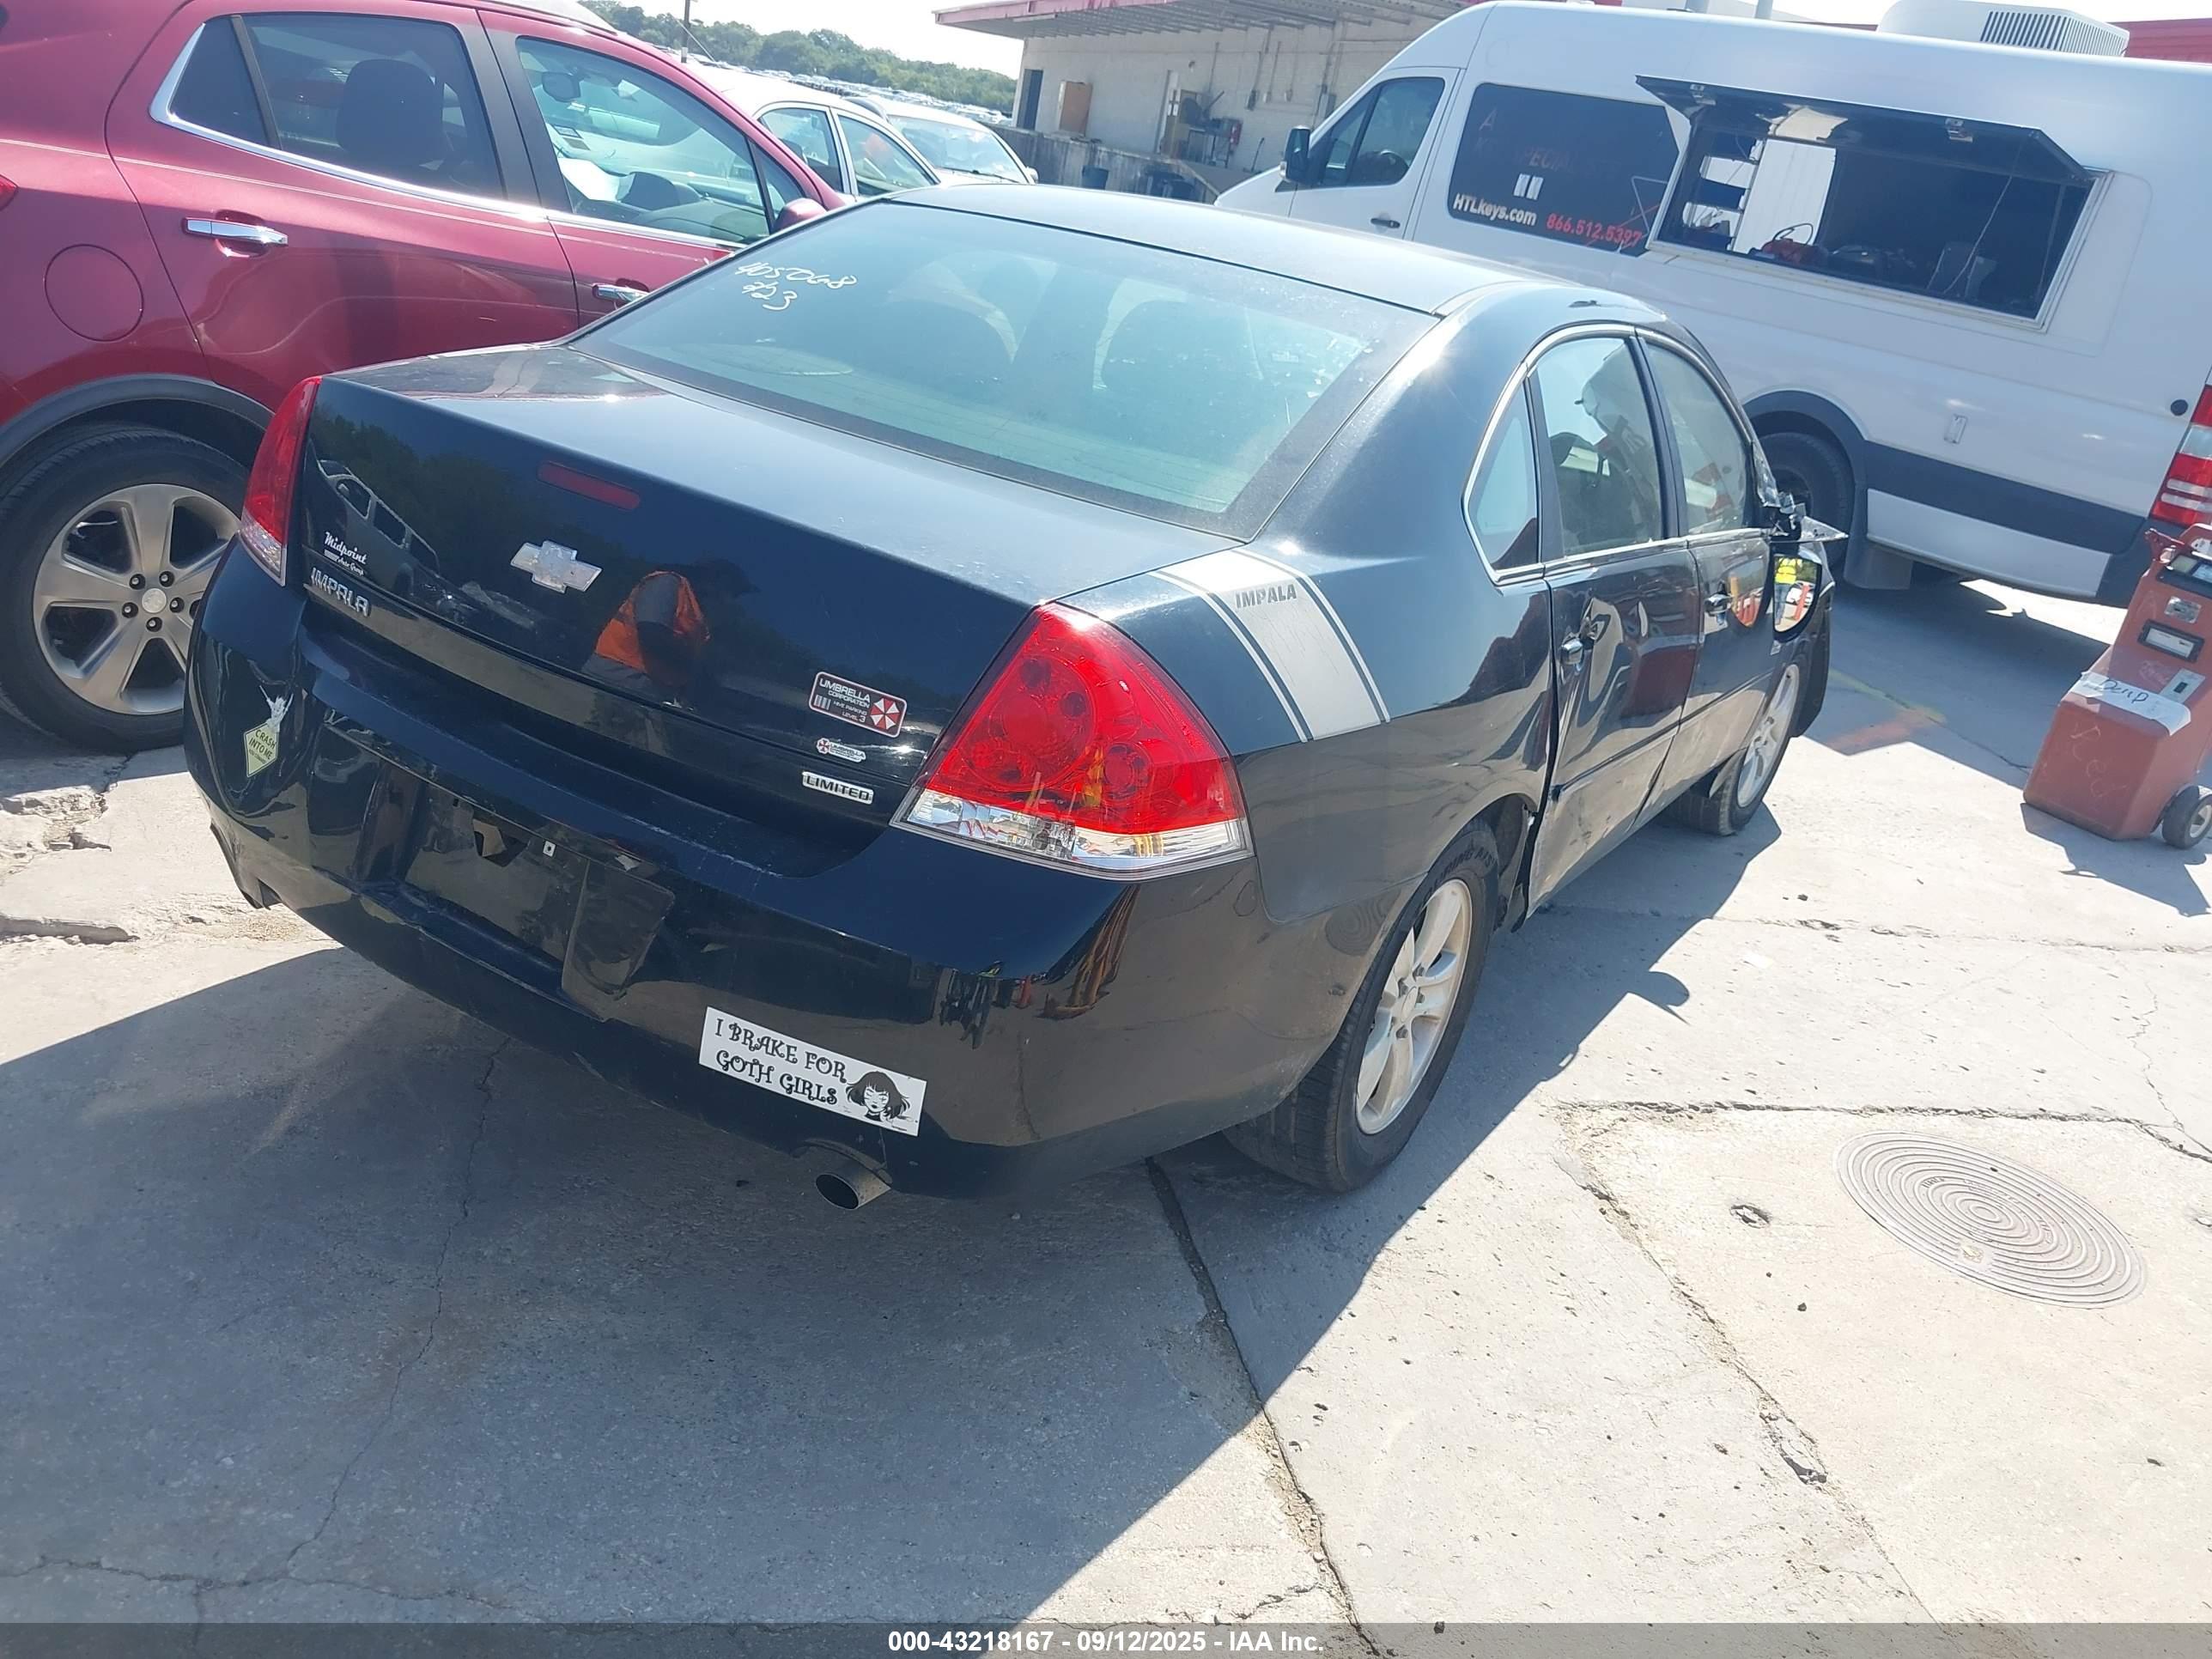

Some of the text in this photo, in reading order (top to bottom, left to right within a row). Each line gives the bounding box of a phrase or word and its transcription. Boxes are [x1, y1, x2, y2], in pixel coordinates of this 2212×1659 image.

[1453, 193, 1643, 248] HTLkeys.com 866.512.5397
[324, 531, 368, 565] Midpoint
[310, 567, 371, 617] IMPALA
[1235, 583, 1297, 609] IMPALA
[819, 678, 871, 703] UMBRELLA
[828, 690, 871, 709] CORPORATION
[842, 711, 866, 723] LEVEL 3
[255, 729, 276, 750] CRASH
[805, 774, 871, 801] LIMITED
[715, 1018, 848, 1084] I BRAKE FOR
[715, 1049, 838, 1105] GOTH GIRLS
